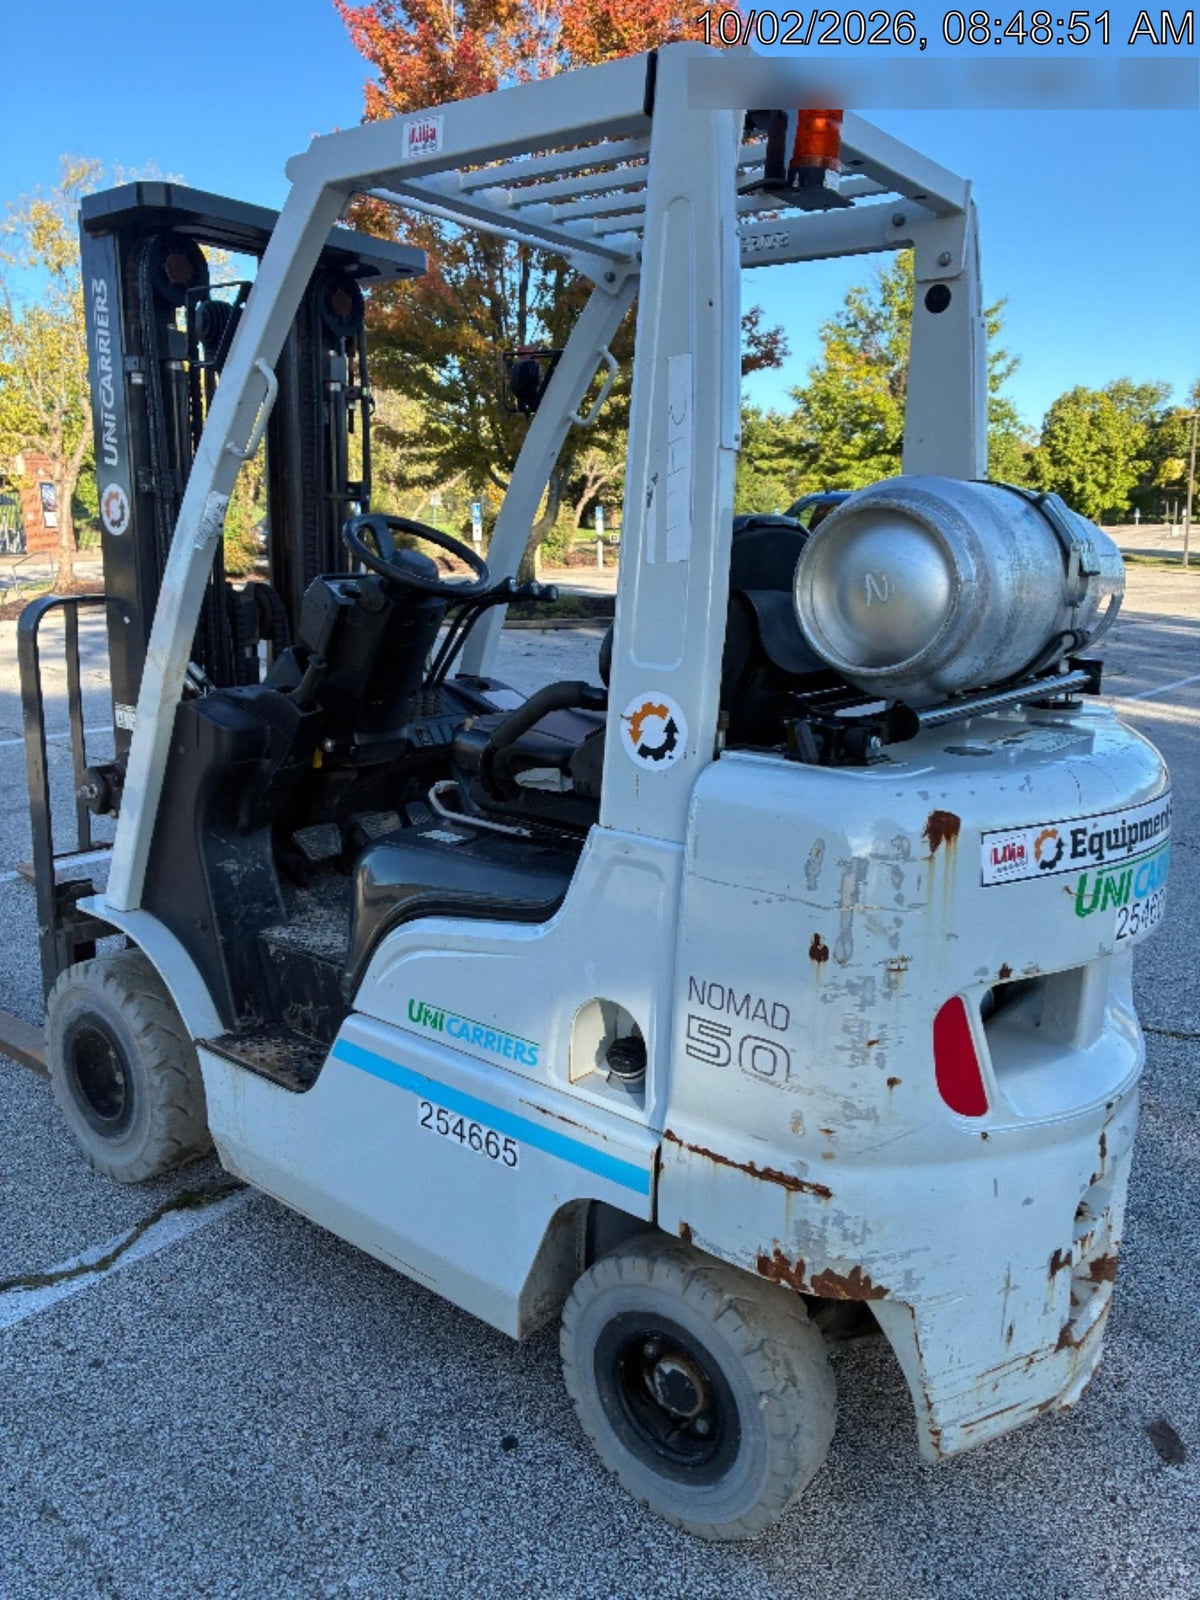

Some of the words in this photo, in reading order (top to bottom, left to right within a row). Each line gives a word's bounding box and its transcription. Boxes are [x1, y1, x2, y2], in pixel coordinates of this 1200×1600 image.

[687, 975, 790, 1032] NOMAD
[685, 1012, 791, 1084] 50
[420, 1101, 517, 1168] 254665
